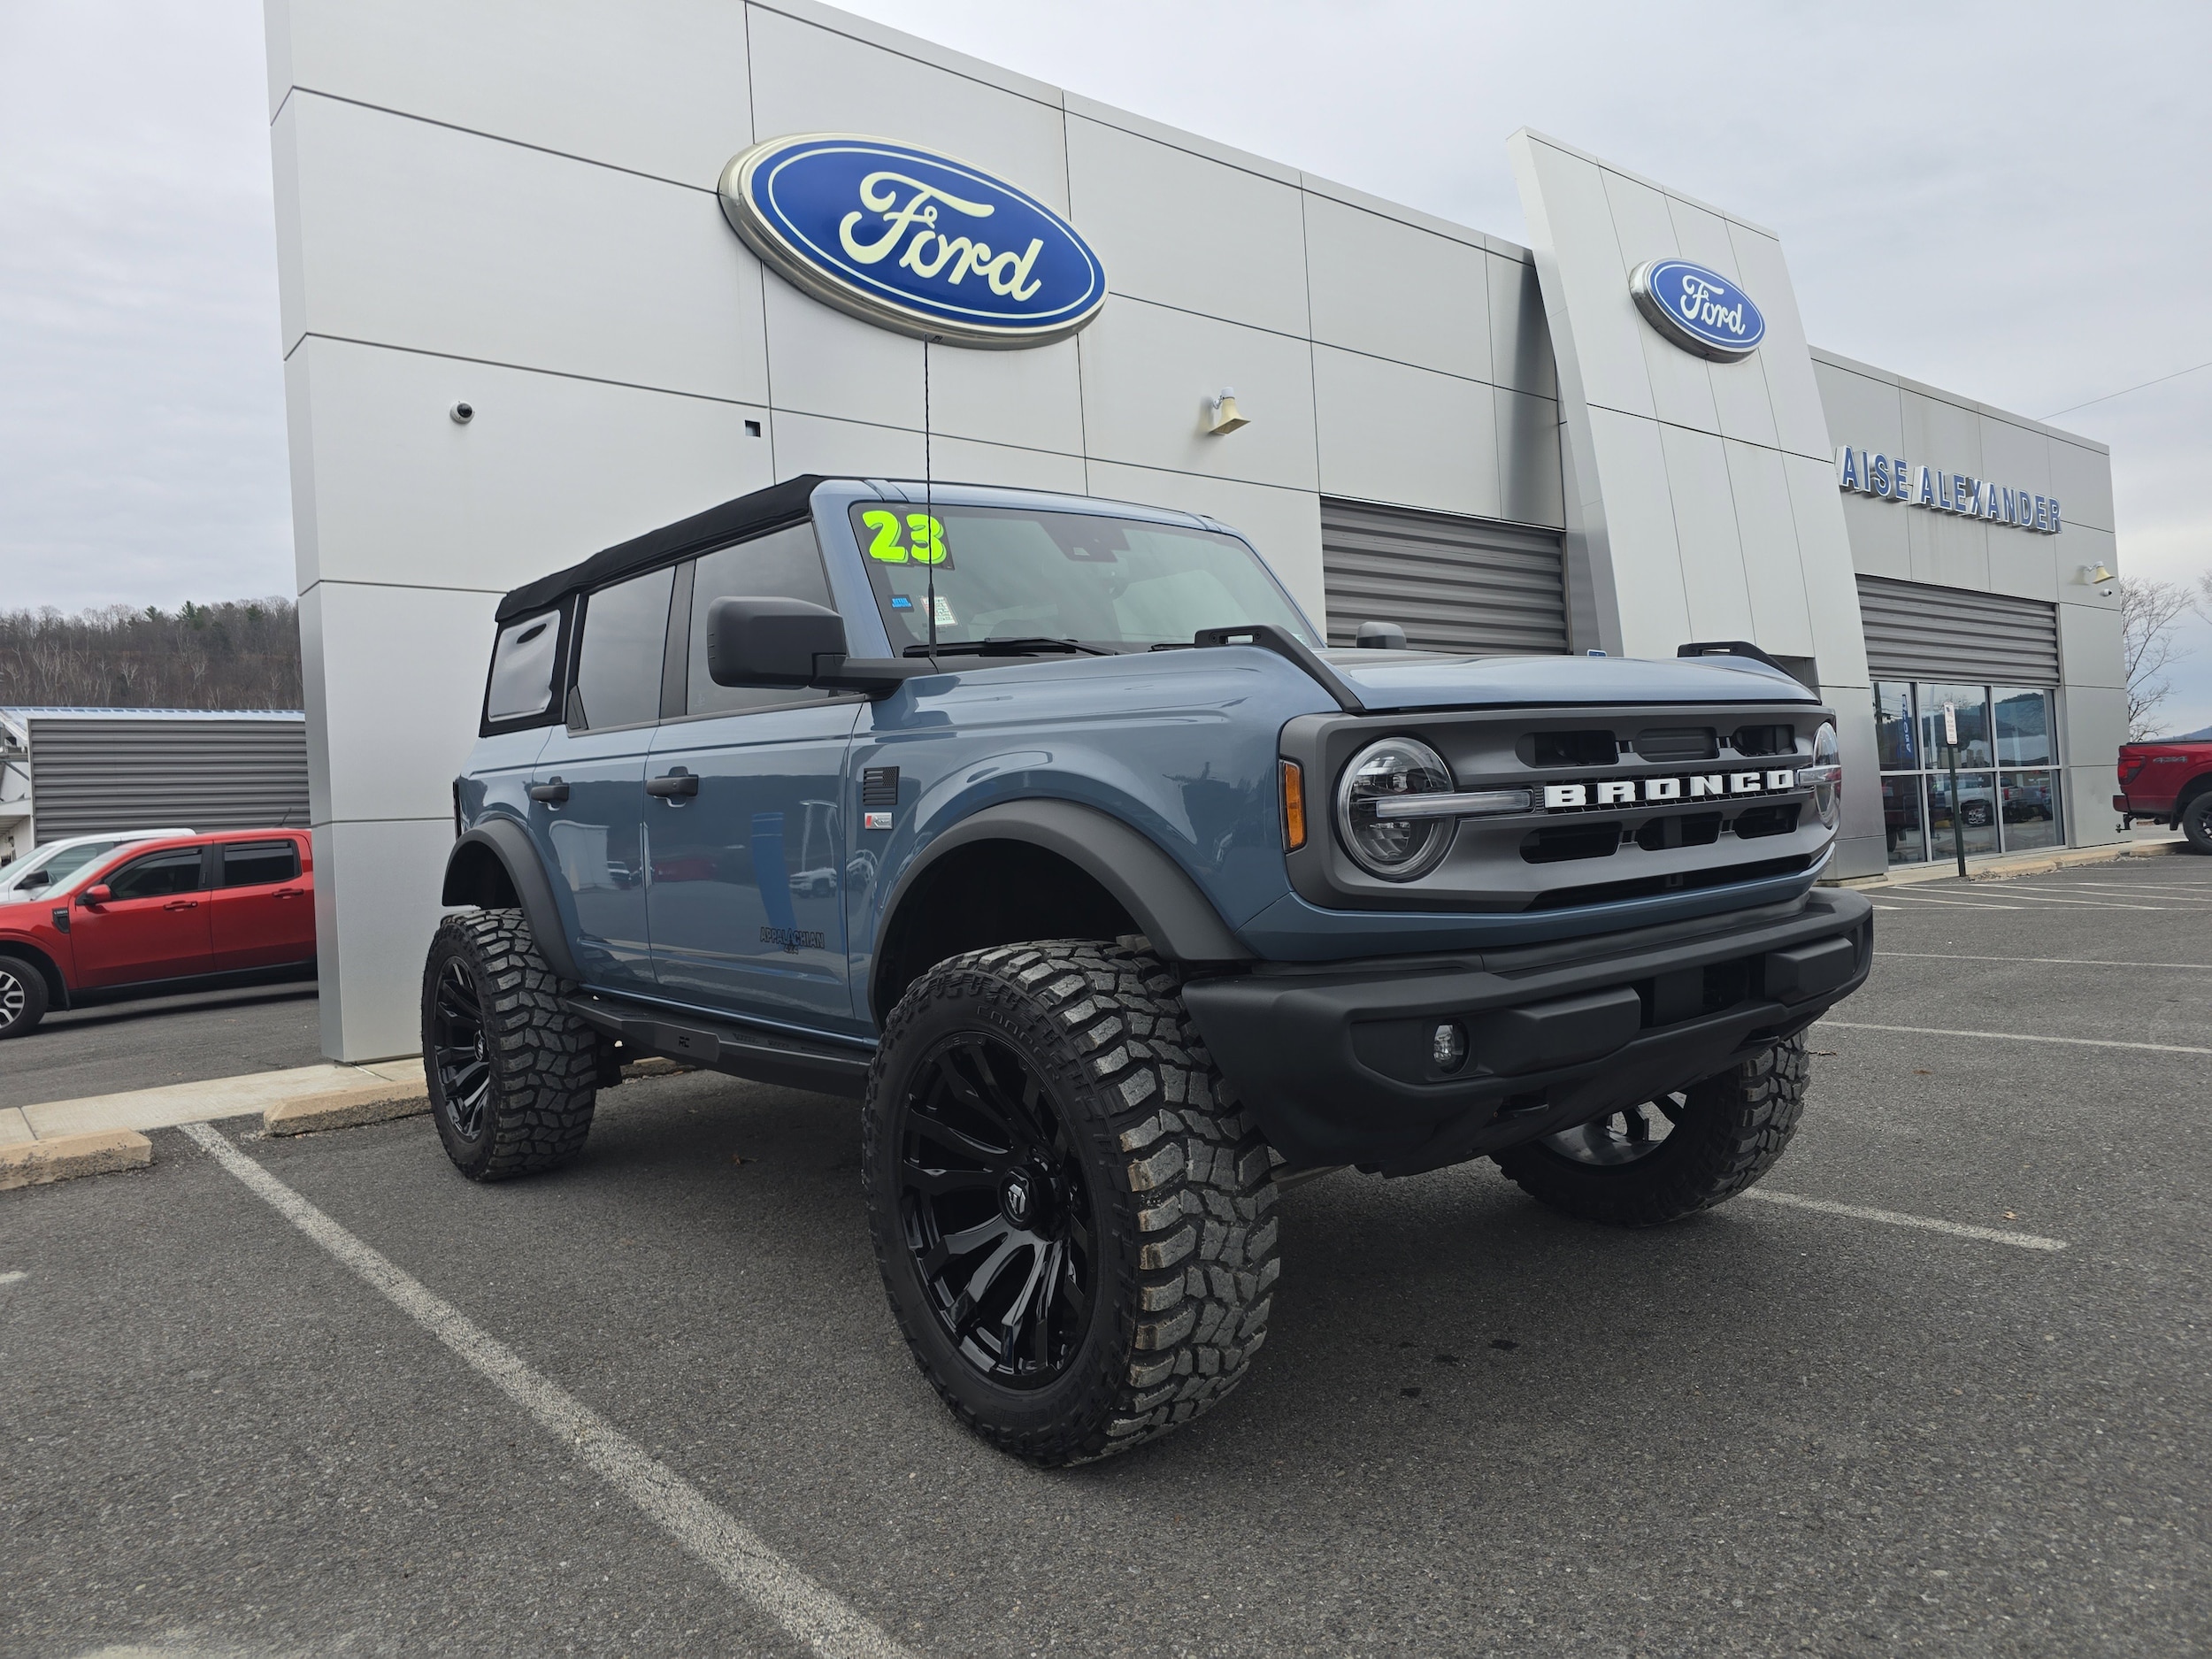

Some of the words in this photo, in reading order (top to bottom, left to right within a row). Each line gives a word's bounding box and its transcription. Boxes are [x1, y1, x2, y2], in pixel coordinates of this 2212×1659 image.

[839, 171, 1044, 302] Ford
[1680, 274, 1747, 335] Ford
[1913, 465, 2062, 534] ALEXANDER
[862, 510, 948, 565] 23
[1544, 769, 1794, 809] BRONCO
[759, 926, 826, 949] APPALACHIAN
